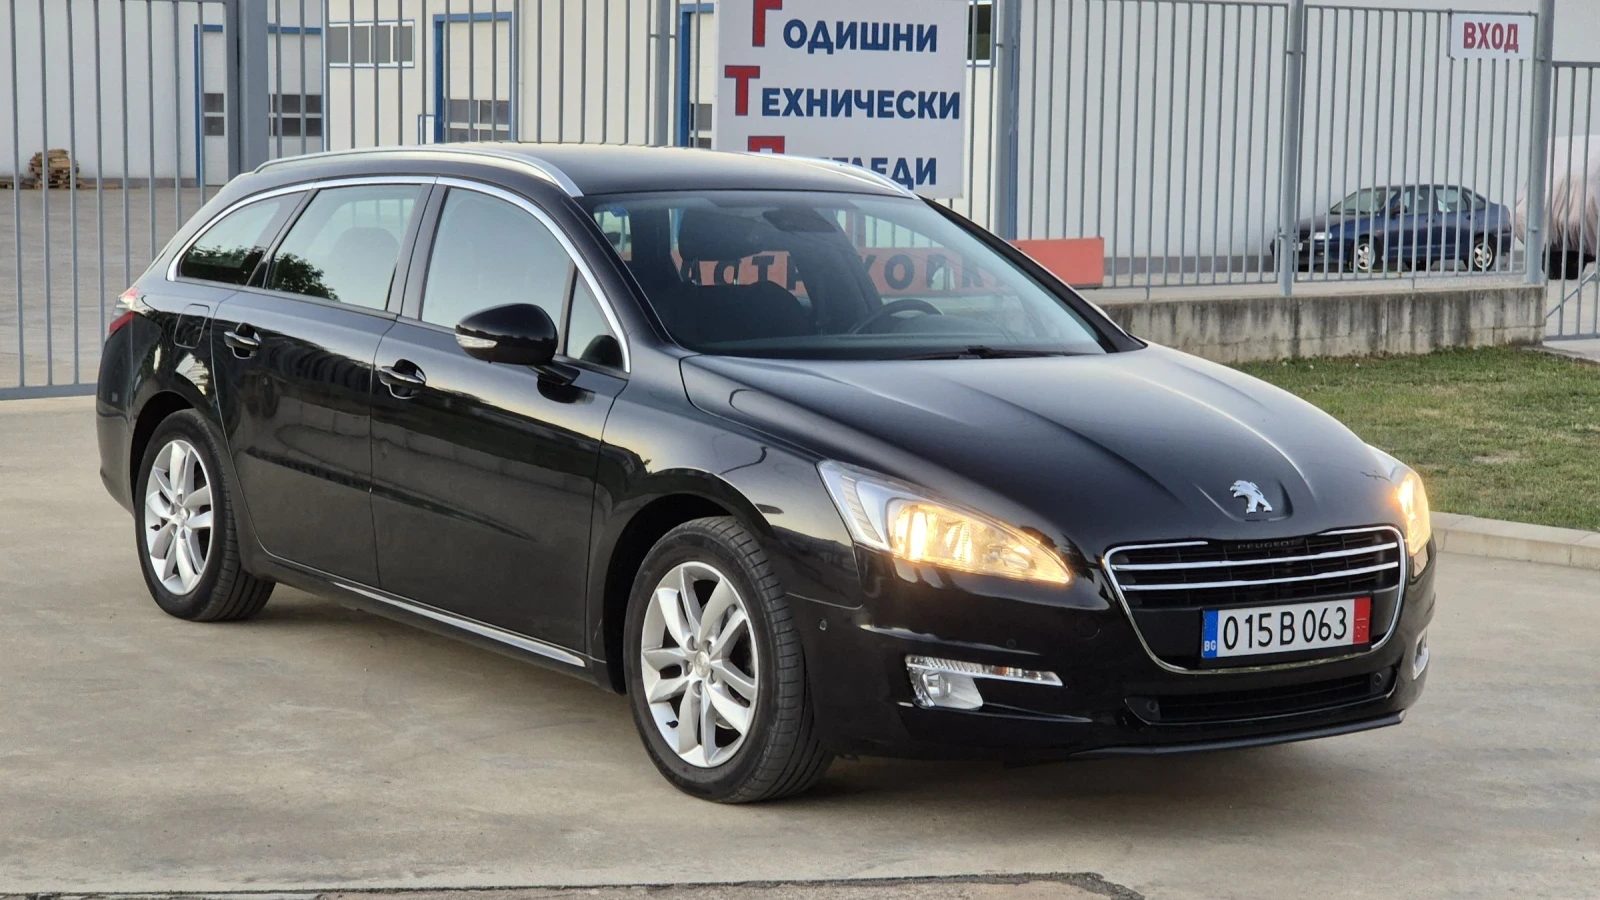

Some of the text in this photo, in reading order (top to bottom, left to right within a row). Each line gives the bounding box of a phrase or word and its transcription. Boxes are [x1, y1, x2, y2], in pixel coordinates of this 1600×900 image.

[752, 0, 937, 54] ГОДИШНИ
[1463, 22, 1519, 53] ВХОД
[724, 65, 960, 119] ТЕХНИЧЕСКИ
[1237, 539, 1297, 550] PEUGEOT
[1204, 640, 1216, 652] BG
